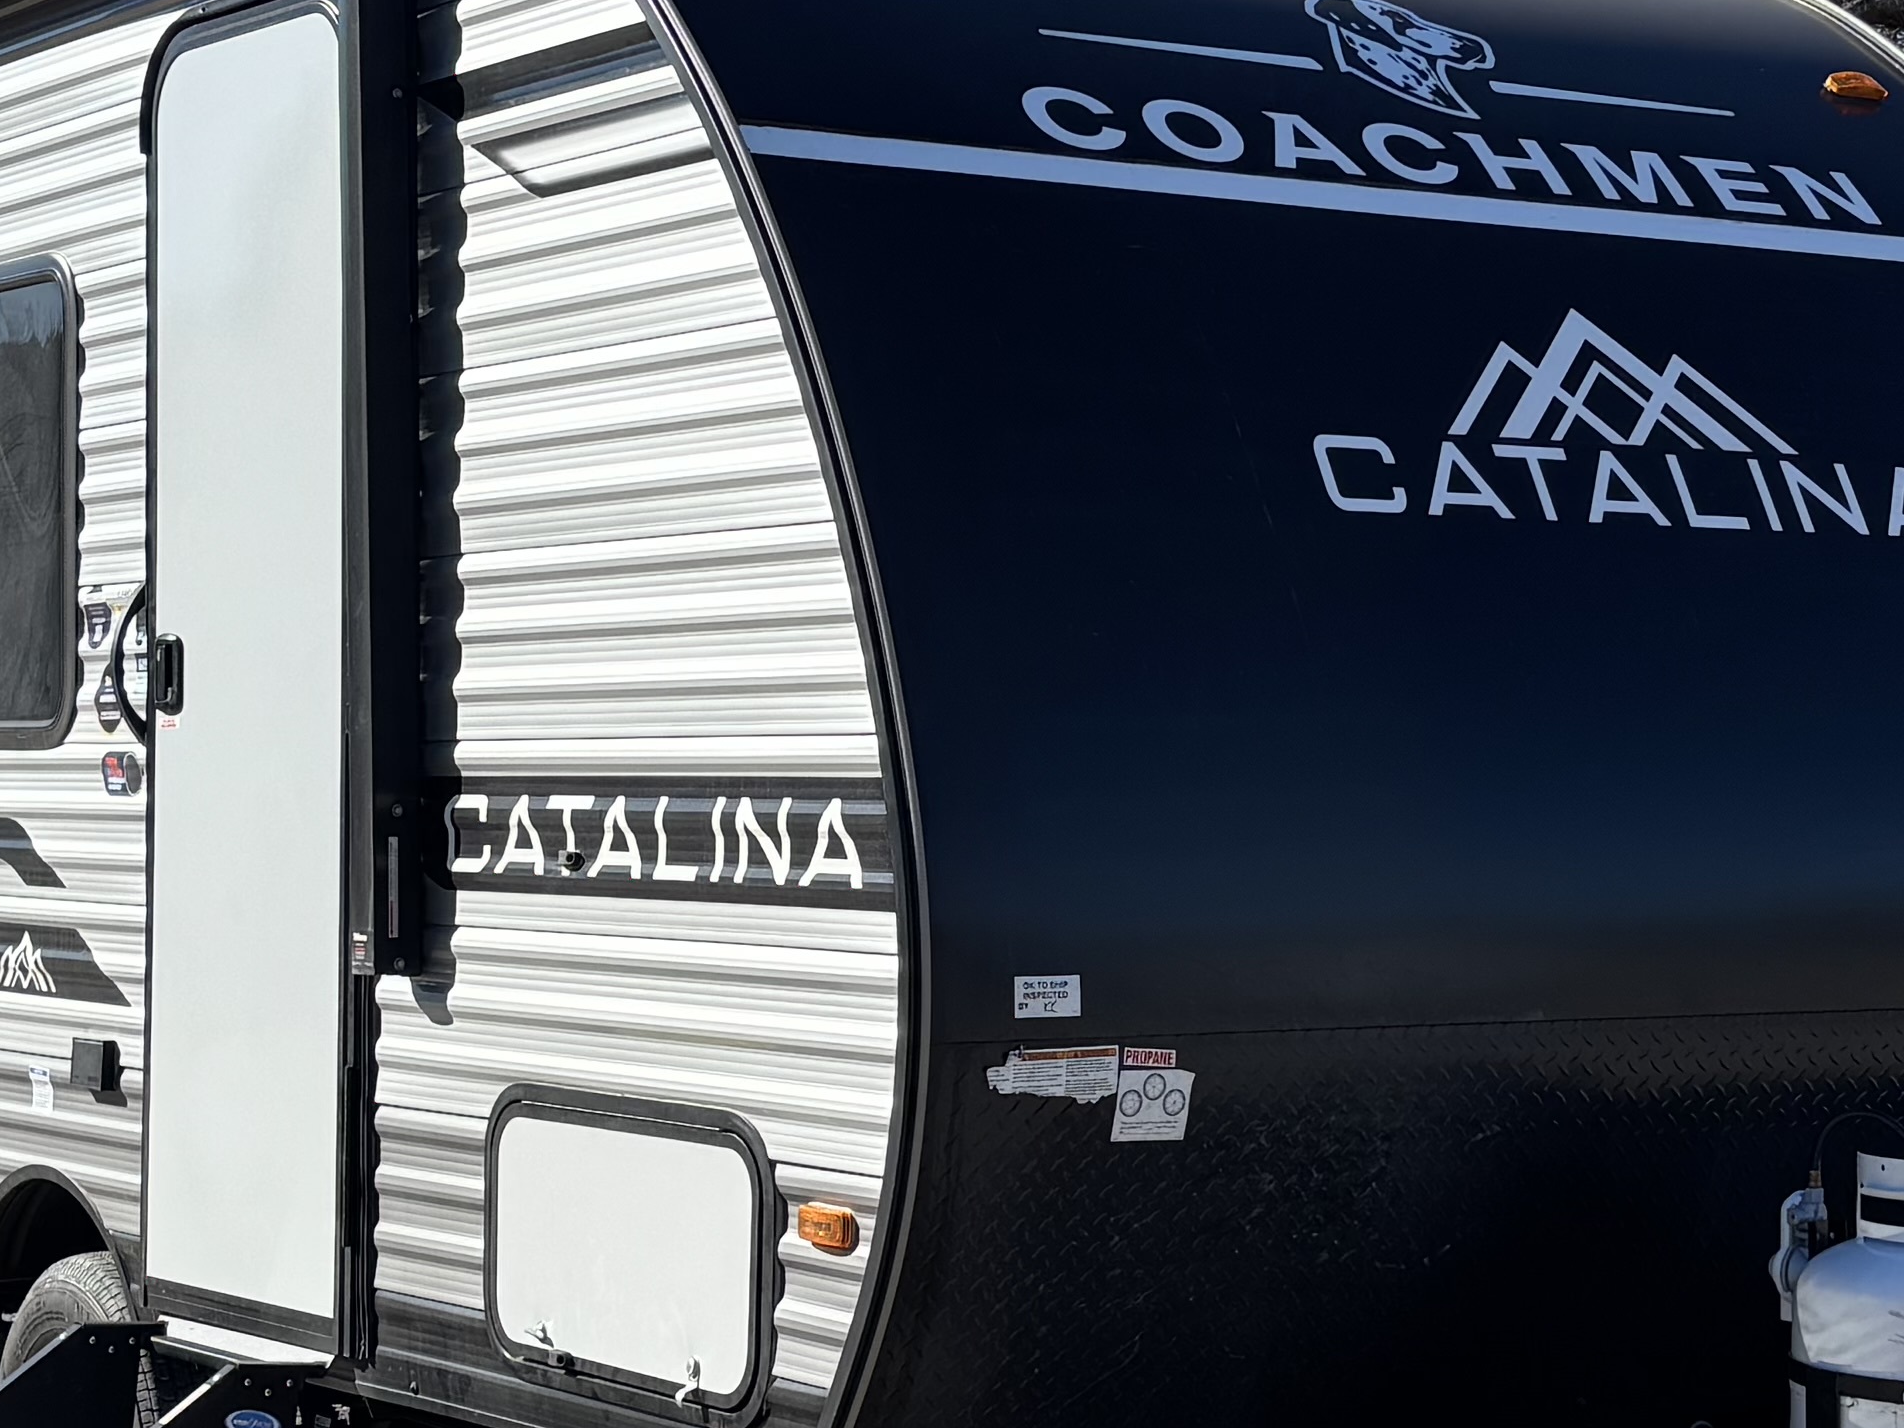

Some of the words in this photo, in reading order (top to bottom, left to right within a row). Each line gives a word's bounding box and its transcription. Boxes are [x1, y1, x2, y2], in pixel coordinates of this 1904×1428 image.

[1021, 86, 1883, 225] COACHMEN
[445, 794, 863, 889] CATALINA
[1125, 1050, 1175, 1065] PROPANE
